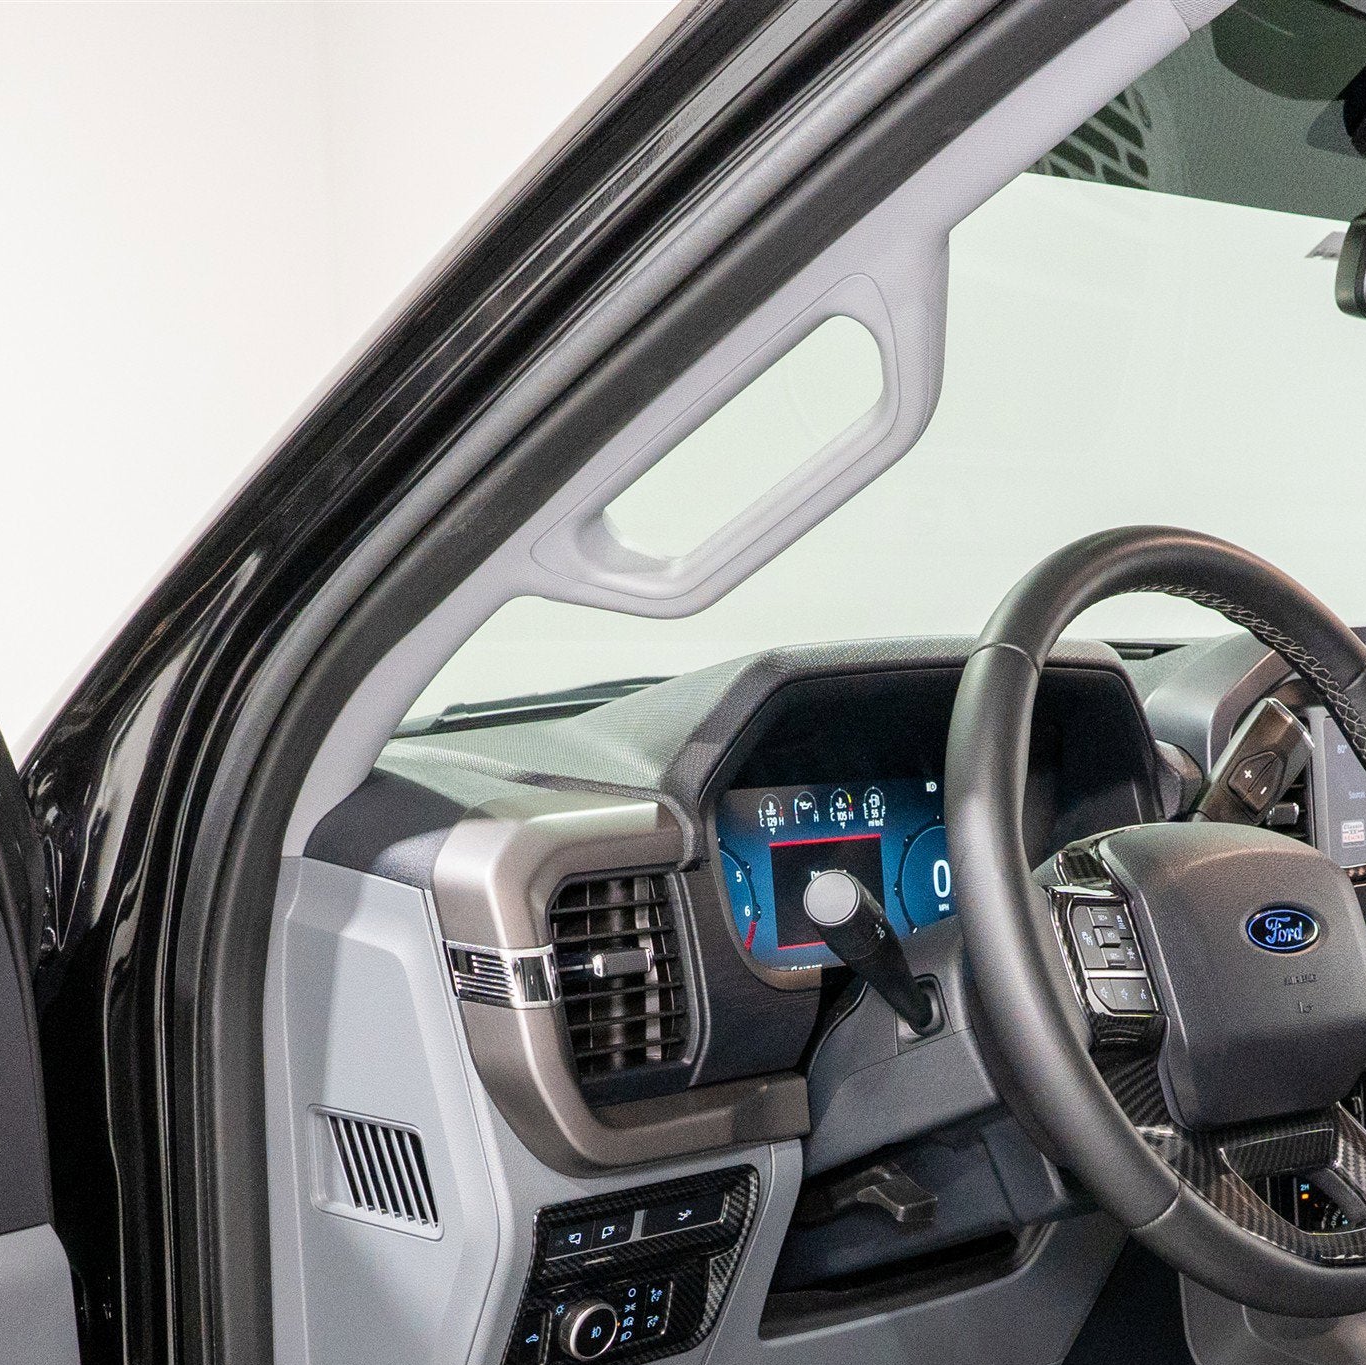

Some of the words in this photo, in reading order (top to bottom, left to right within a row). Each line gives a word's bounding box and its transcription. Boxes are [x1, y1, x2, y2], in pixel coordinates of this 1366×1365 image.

[735, 870, 742, 883] 5
[933, 859, 951, 898] 0
[744, 905, 751, 917] 6
[1265, 916, 1303, 944] Ford
[1299, 1183, 1310, 1192] 2H
